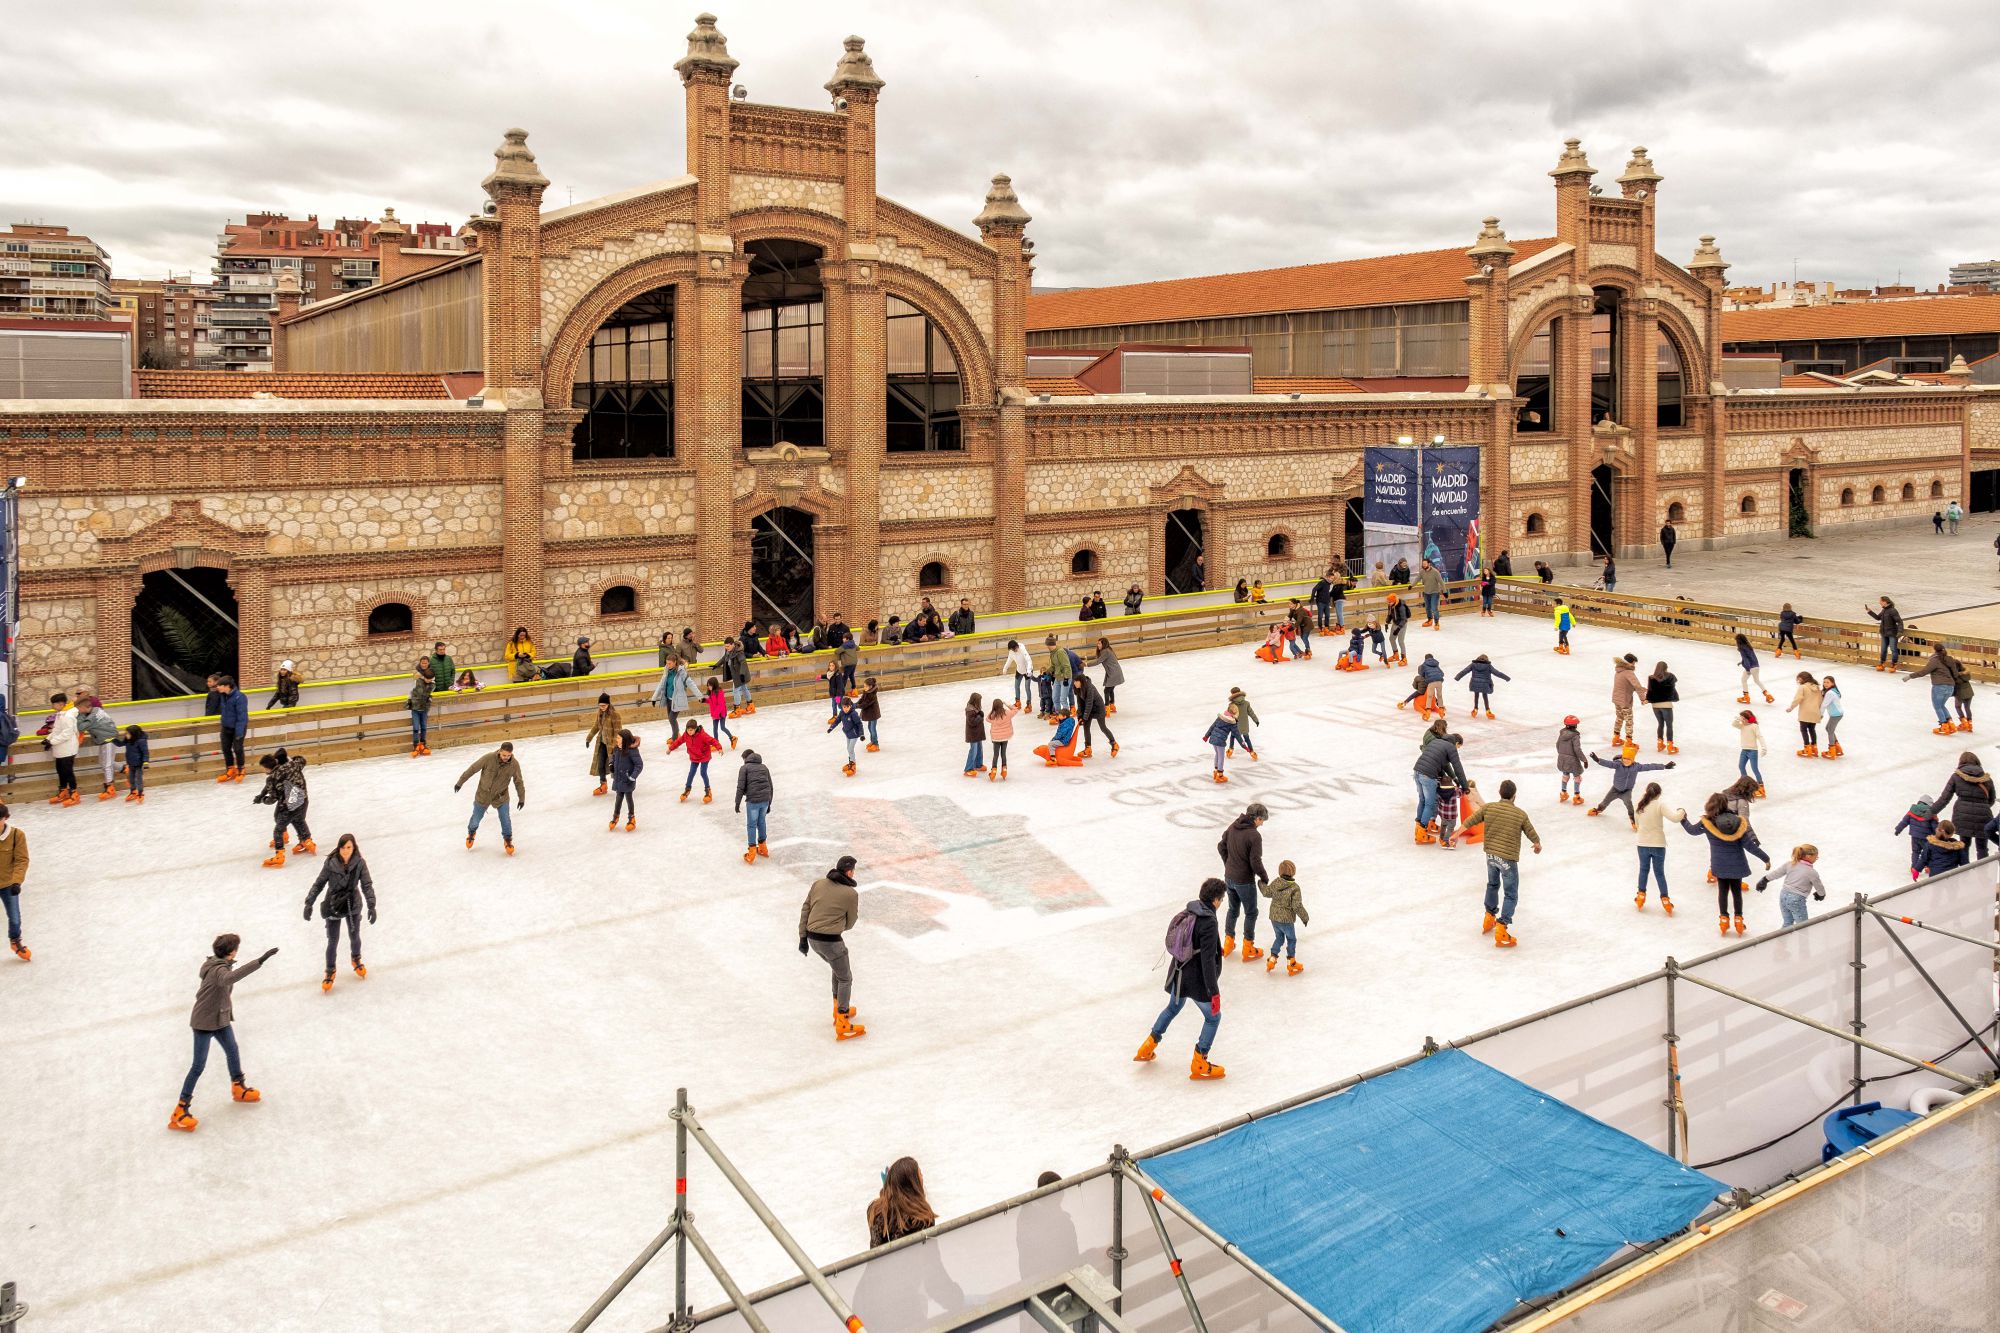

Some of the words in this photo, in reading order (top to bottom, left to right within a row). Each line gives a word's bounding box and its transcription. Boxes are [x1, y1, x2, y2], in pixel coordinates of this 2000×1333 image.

[1375, 473, 1407, 485] MADRID
[1432, 473, 1468, 488] MADRID
[1375, 485, 1407, 496] NAVIDAD
[1431, 490, 1468, 505] NAVIDAD
[1431, 507, 1440, 516] de
[1440, 505, 1468, 516] encuentro
